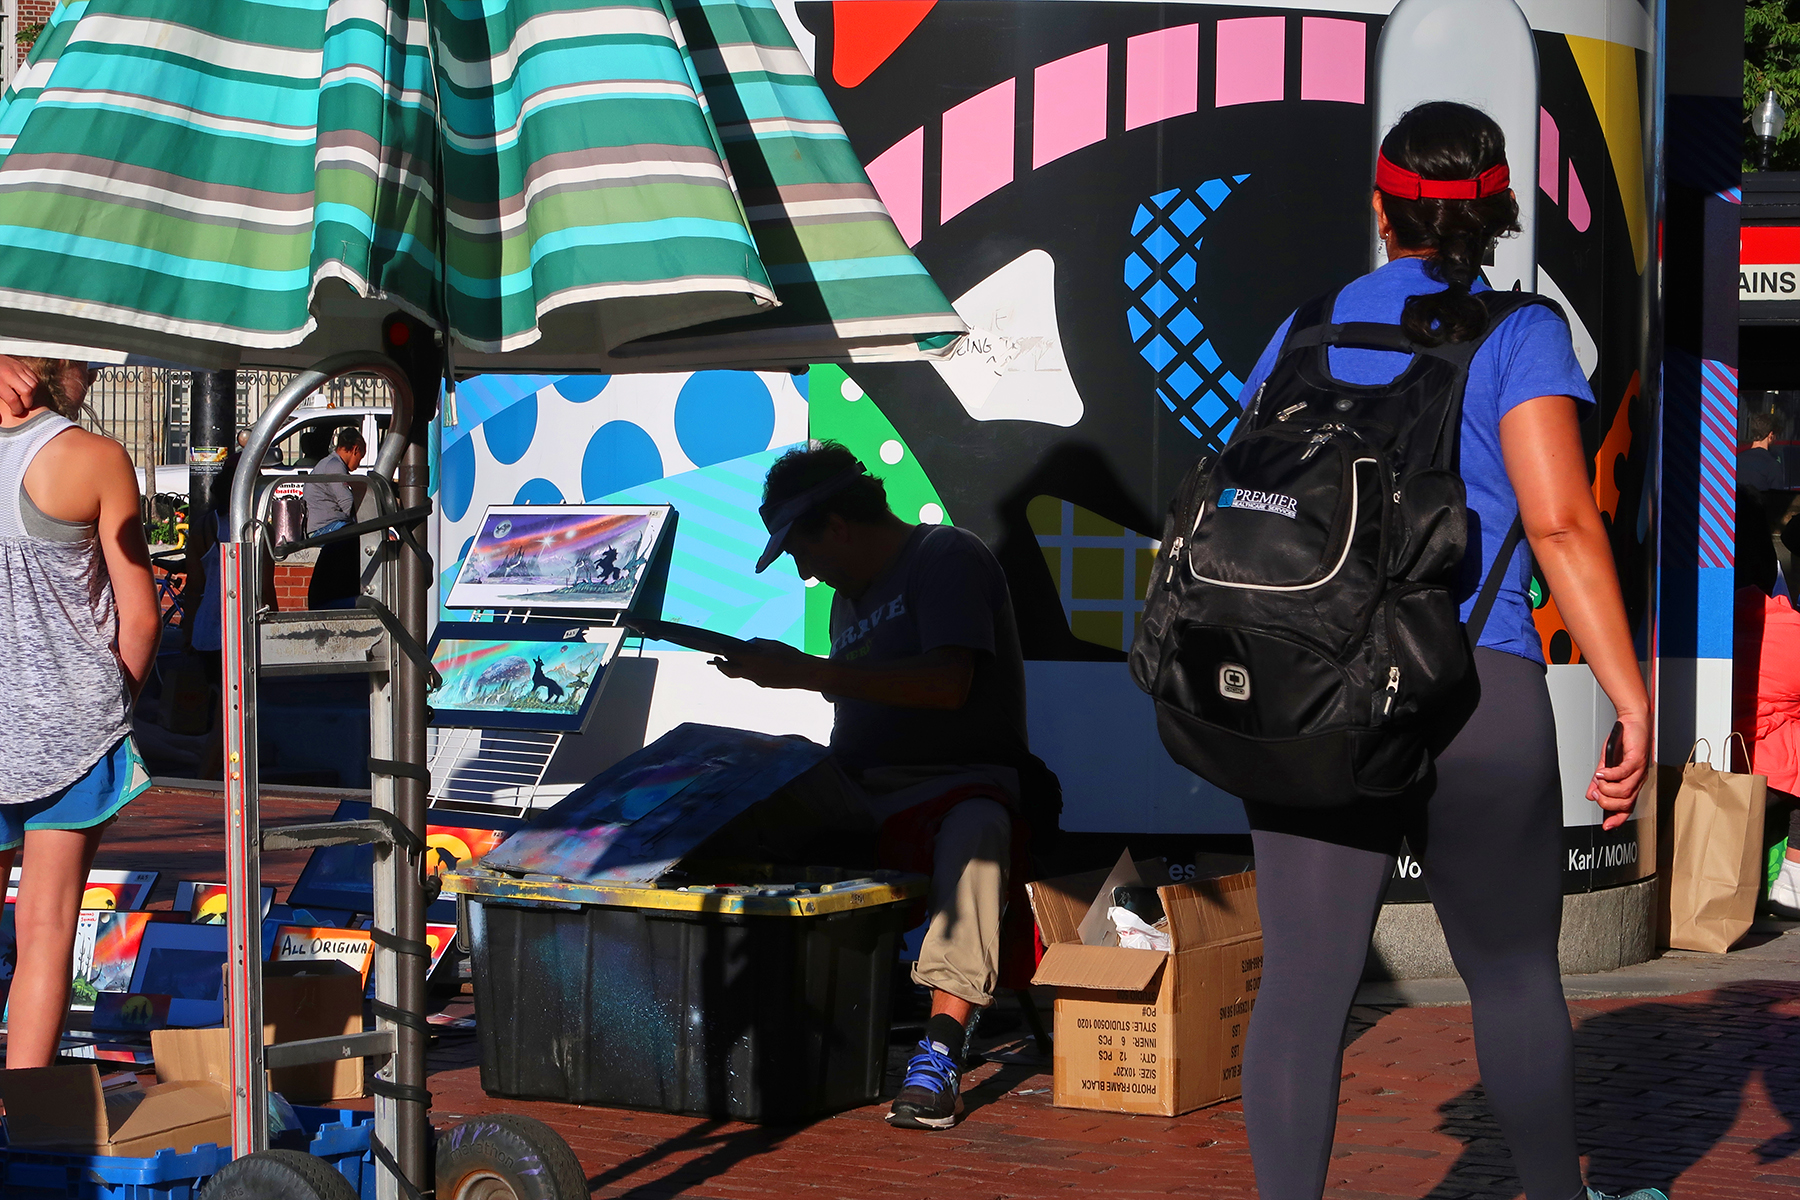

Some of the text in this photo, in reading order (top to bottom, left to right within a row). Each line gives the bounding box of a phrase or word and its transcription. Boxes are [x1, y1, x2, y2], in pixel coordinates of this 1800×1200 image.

[1234, 488, 1297, 512] PREMIER
[1568, 846, 1595, 871] Karl
[1605, 841, 1638, 867] MOMO
[1162, 856, 1196, 881] es
[281, 934, 373, 955] ALL ORIGINAL
[1142, 1006, 1156, 1017] PO#
[1077, 1018, 1092, 1028] 1020
[1132, 1021, 1156, 1033] STYLE:
[1098, 1035, 1156, 1048] INNER: 6 PCS
[1098, 1050, 1156, 1064] QTY: 12 PCS
[1138, 1068, 1156, 1079] SIZE:
[1081, 1079, 1156, 1095] PHOTO FRAME BLACK
[449, 1138, 514, 1168] marathon
